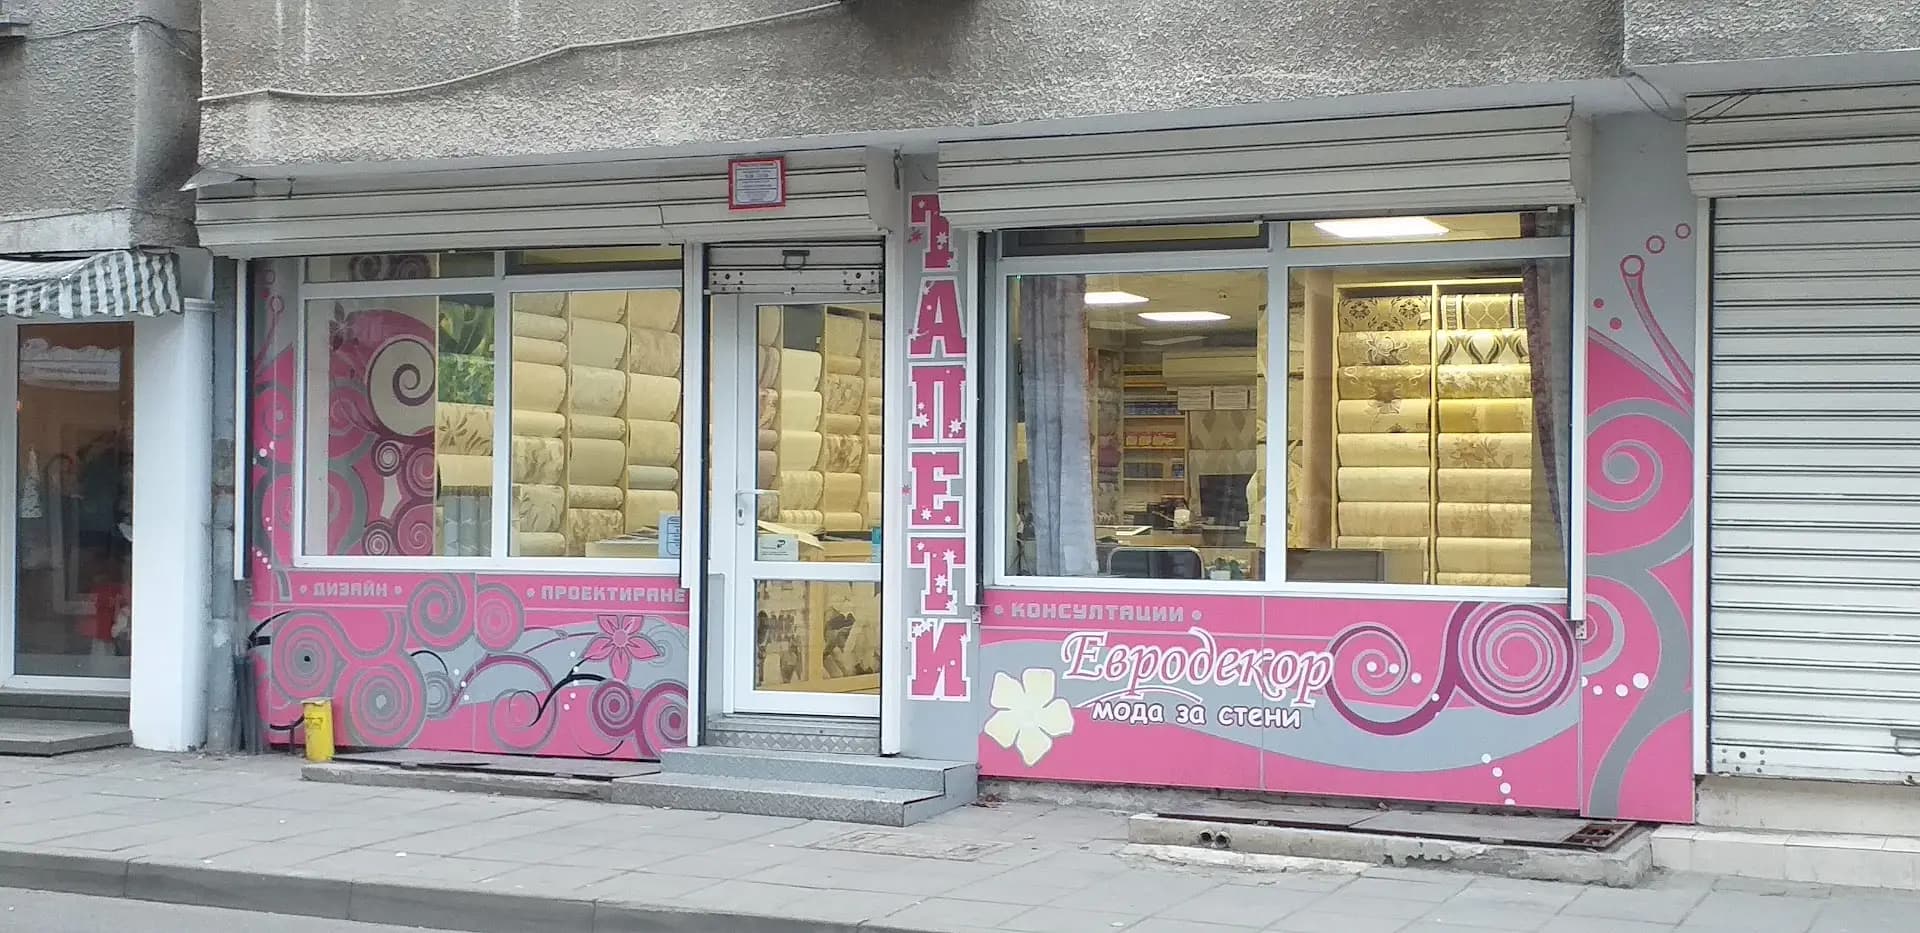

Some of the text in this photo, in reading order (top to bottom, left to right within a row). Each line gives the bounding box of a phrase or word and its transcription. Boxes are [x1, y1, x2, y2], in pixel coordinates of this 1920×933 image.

[908, 193, 970, 702] ТАПЕТИ
[313, 582, 388, 598] ДИЗАЙН
[541, 586, 686, 604] ПРОЕКТИРАНЕ
[1011, 602, 1184, 623] КОНСУЛТАЦИИ
[1062, 627, 1333, 708] Евродекор
[1091, 700, 1302, 729] мода за стени
